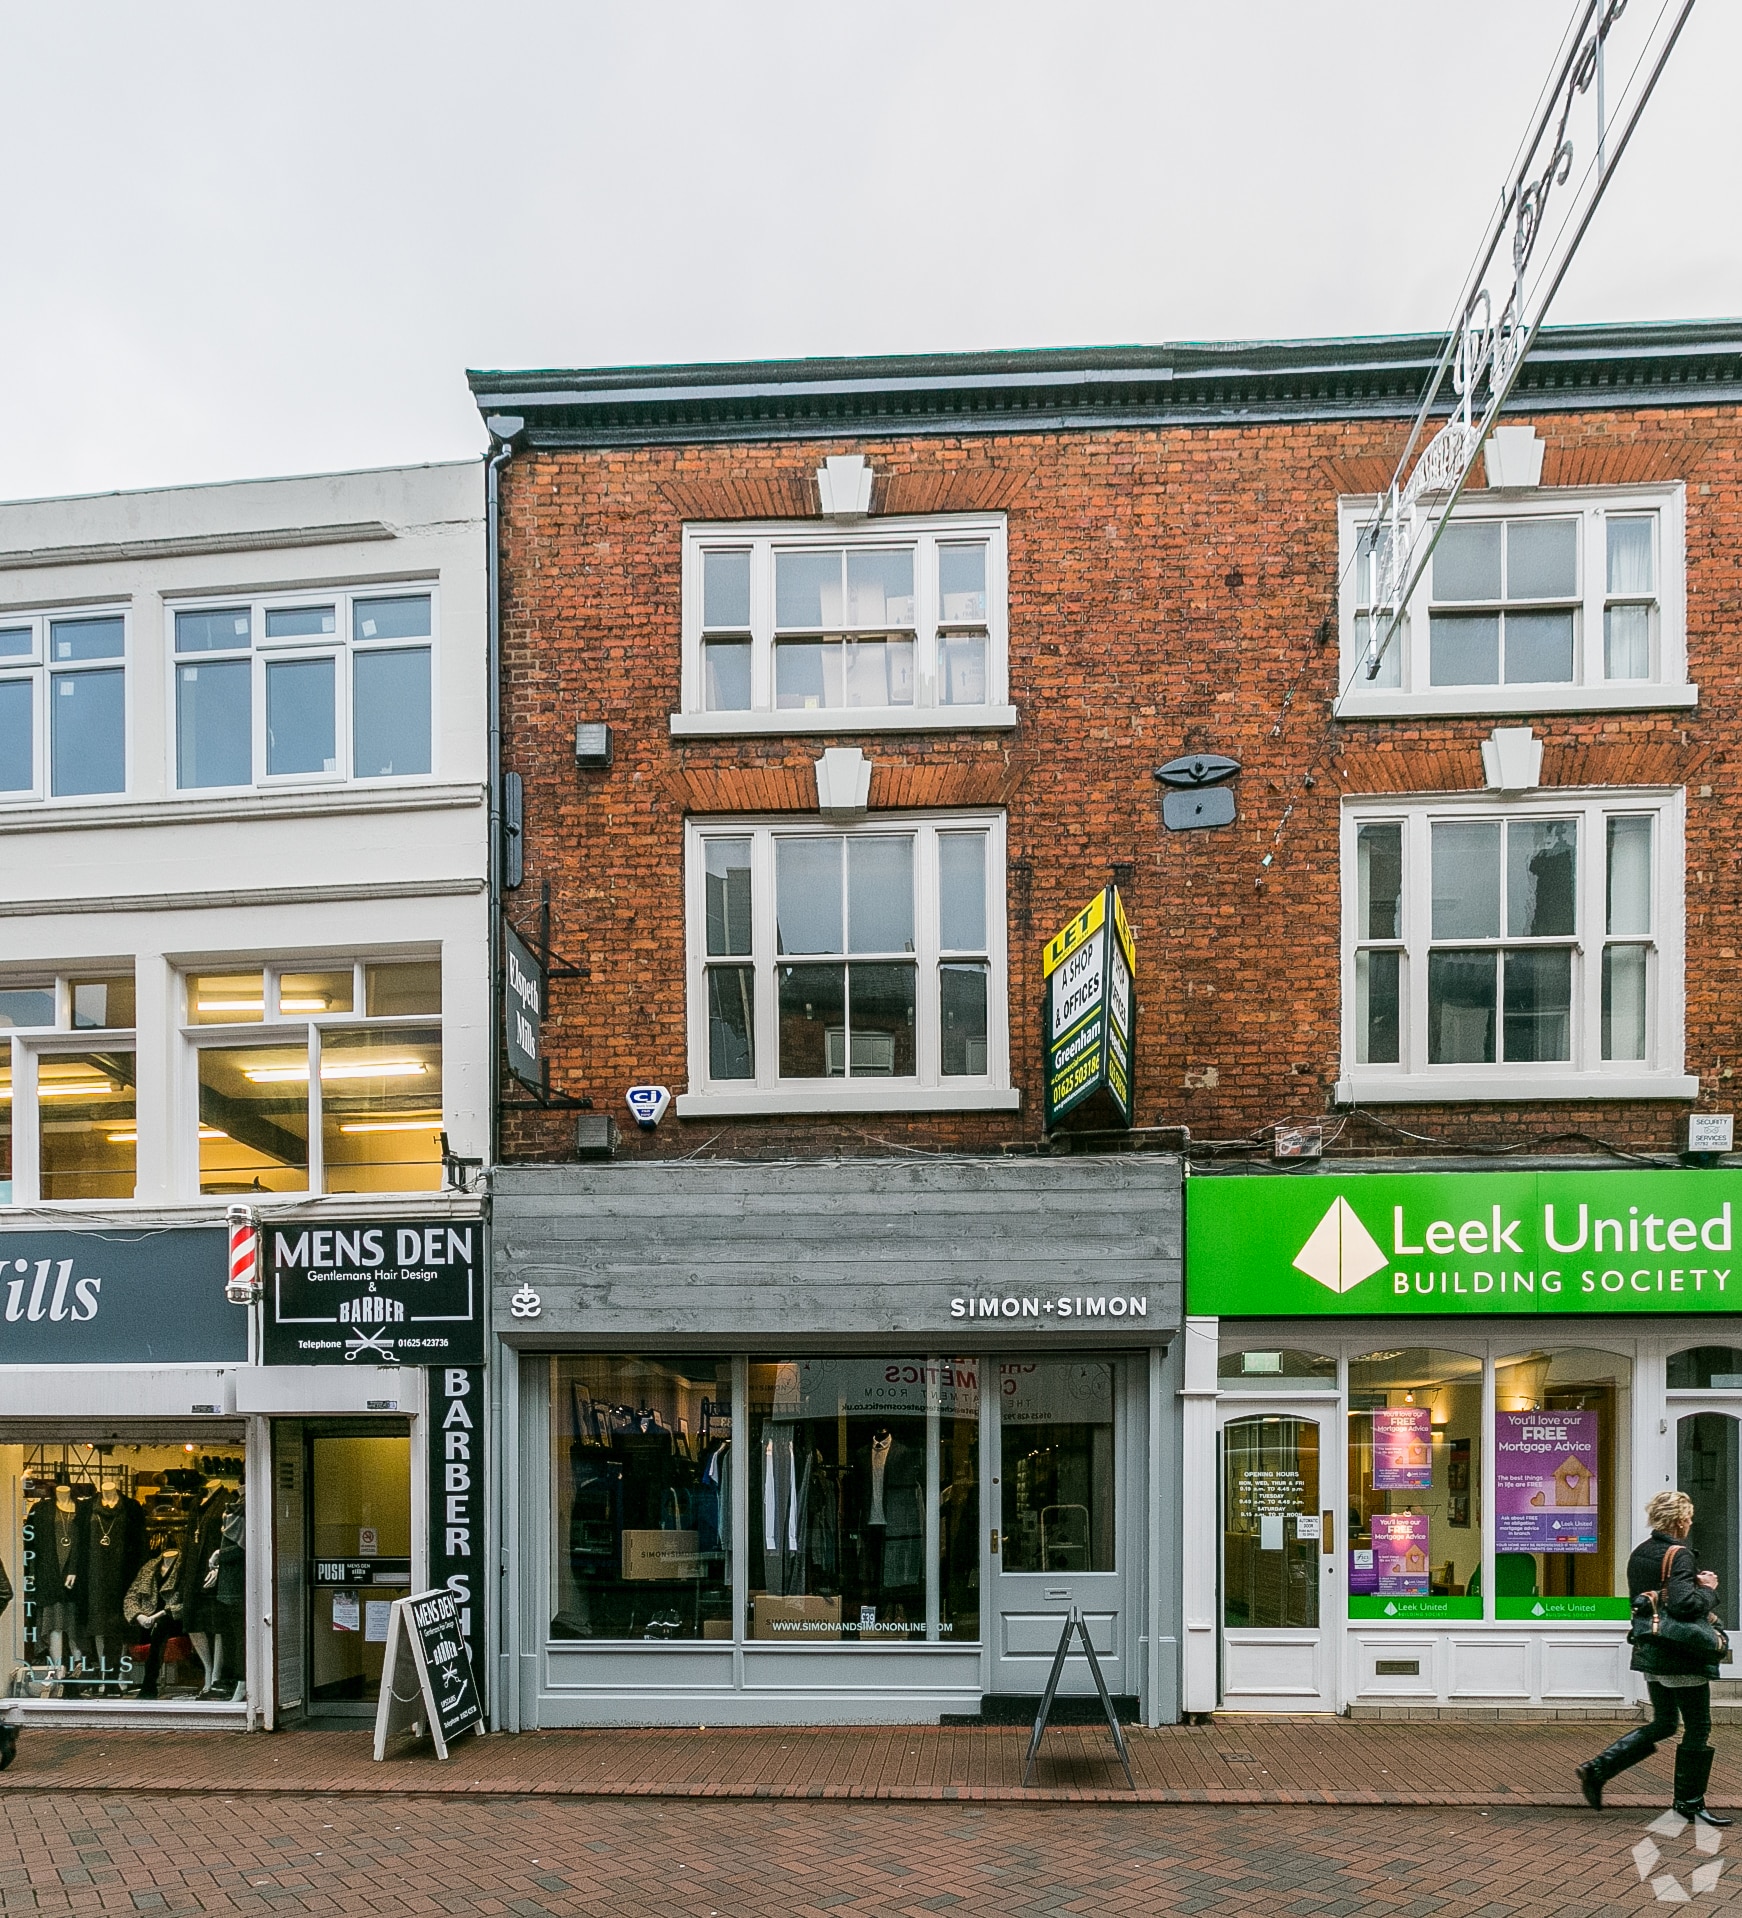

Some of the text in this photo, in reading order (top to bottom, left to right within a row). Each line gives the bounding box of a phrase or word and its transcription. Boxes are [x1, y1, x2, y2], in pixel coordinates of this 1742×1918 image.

[1052, 905, 1093, 962] LET
[1062, 943, 1093, 990] A SHOP
[509, 950, 539, 1015] Elspeth
[1055, 1008, 1061, 1029] &
[1063, 972, 1100, 1020] OFFICES
[515, 1009, 536, 1060] Mills
[1055, 1021, 1100, 1069] Greenham
[1055, 1057, 1080, 1083] Commercial
[1053, 1074, 1074, 1104] 01625
[1394, 1202, 1732, 1255] Leek United
[275, 1228, 472, 1268] MENS DEN
[307, 1269, 438, 1282] Gentlemans Hair Design
[368, 1282, 377, 1292] &
[1394, 1269, 1732, 1294] BUILDING SOCIETY
[0, 1258, 101, 1322] ills
[340, 1296, 404, 1323] BARBER
[950, 1297, 1147, 1317] SIMON+SIMON
[298, 1338, 448, 1349] Telephone 01625 423736
[1508, 1415, 1581, 1425] You'll love our
[1522, 1427, 1567, 1440] FREE
[1499, 1442, 1591, 1453] Mortgage Advice
[442, 1368, 473, 1556] BARBER
[22, 1479, 38, 1643] ELSPETH
[318, 1563, 345, 1580] PUSH
[413, 1599, 440, 1629] MENS
[438, 1594, 456, 1620] DEN
[1398, 1603, 1448, 1611] Leek United
[1545, 1603, 1596, 1611] Leek United
[772, 1623, 952, 1632] WWW.SIMONANDSIMONONLINEOM
[46, 1655, 133, 1673] MILLS
[433, 1640, 458, 1666] BARBER
